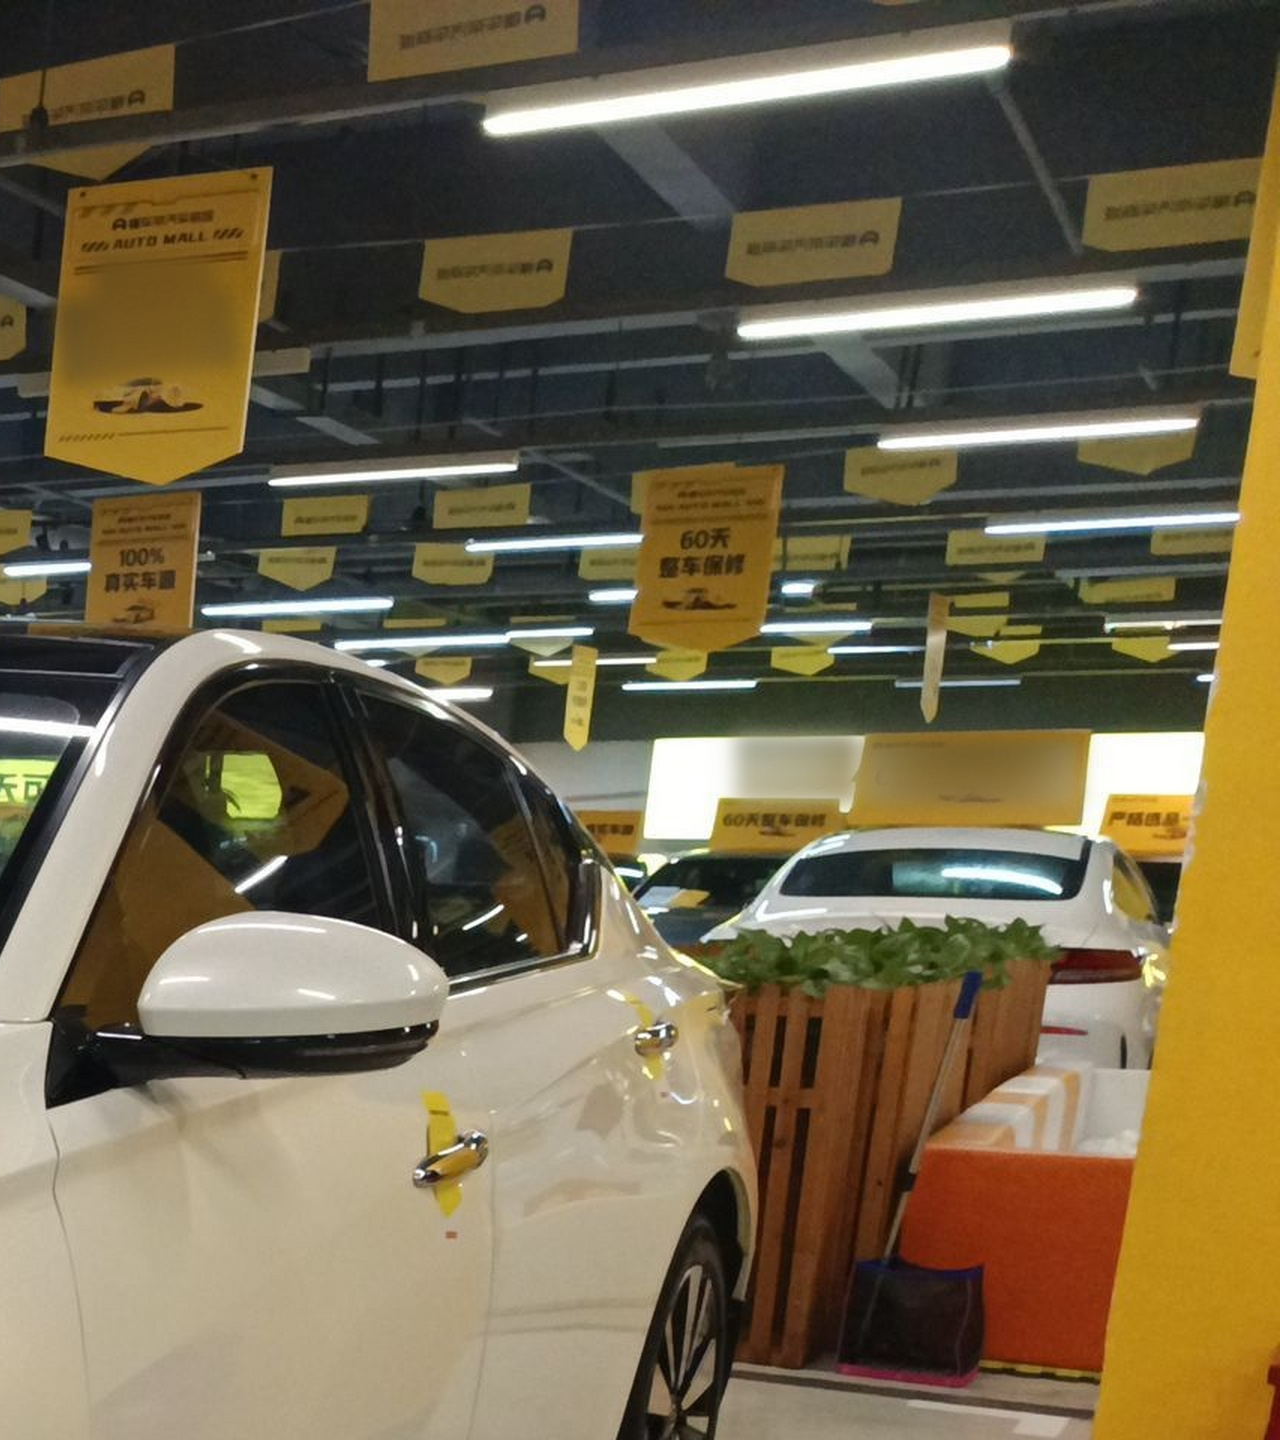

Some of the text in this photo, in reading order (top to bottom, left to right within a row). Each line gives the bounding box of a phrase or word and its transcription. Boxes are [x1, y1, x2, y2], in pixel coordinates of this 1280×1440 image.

[112, 231, 208, 251] AUTO MALL
[680, 526, 731, 550] 60天
[120, 547, 165, 567] 100%
[659, 553, 747, 579] 整车保修
[104, 570, 177, 593] 真实车源
